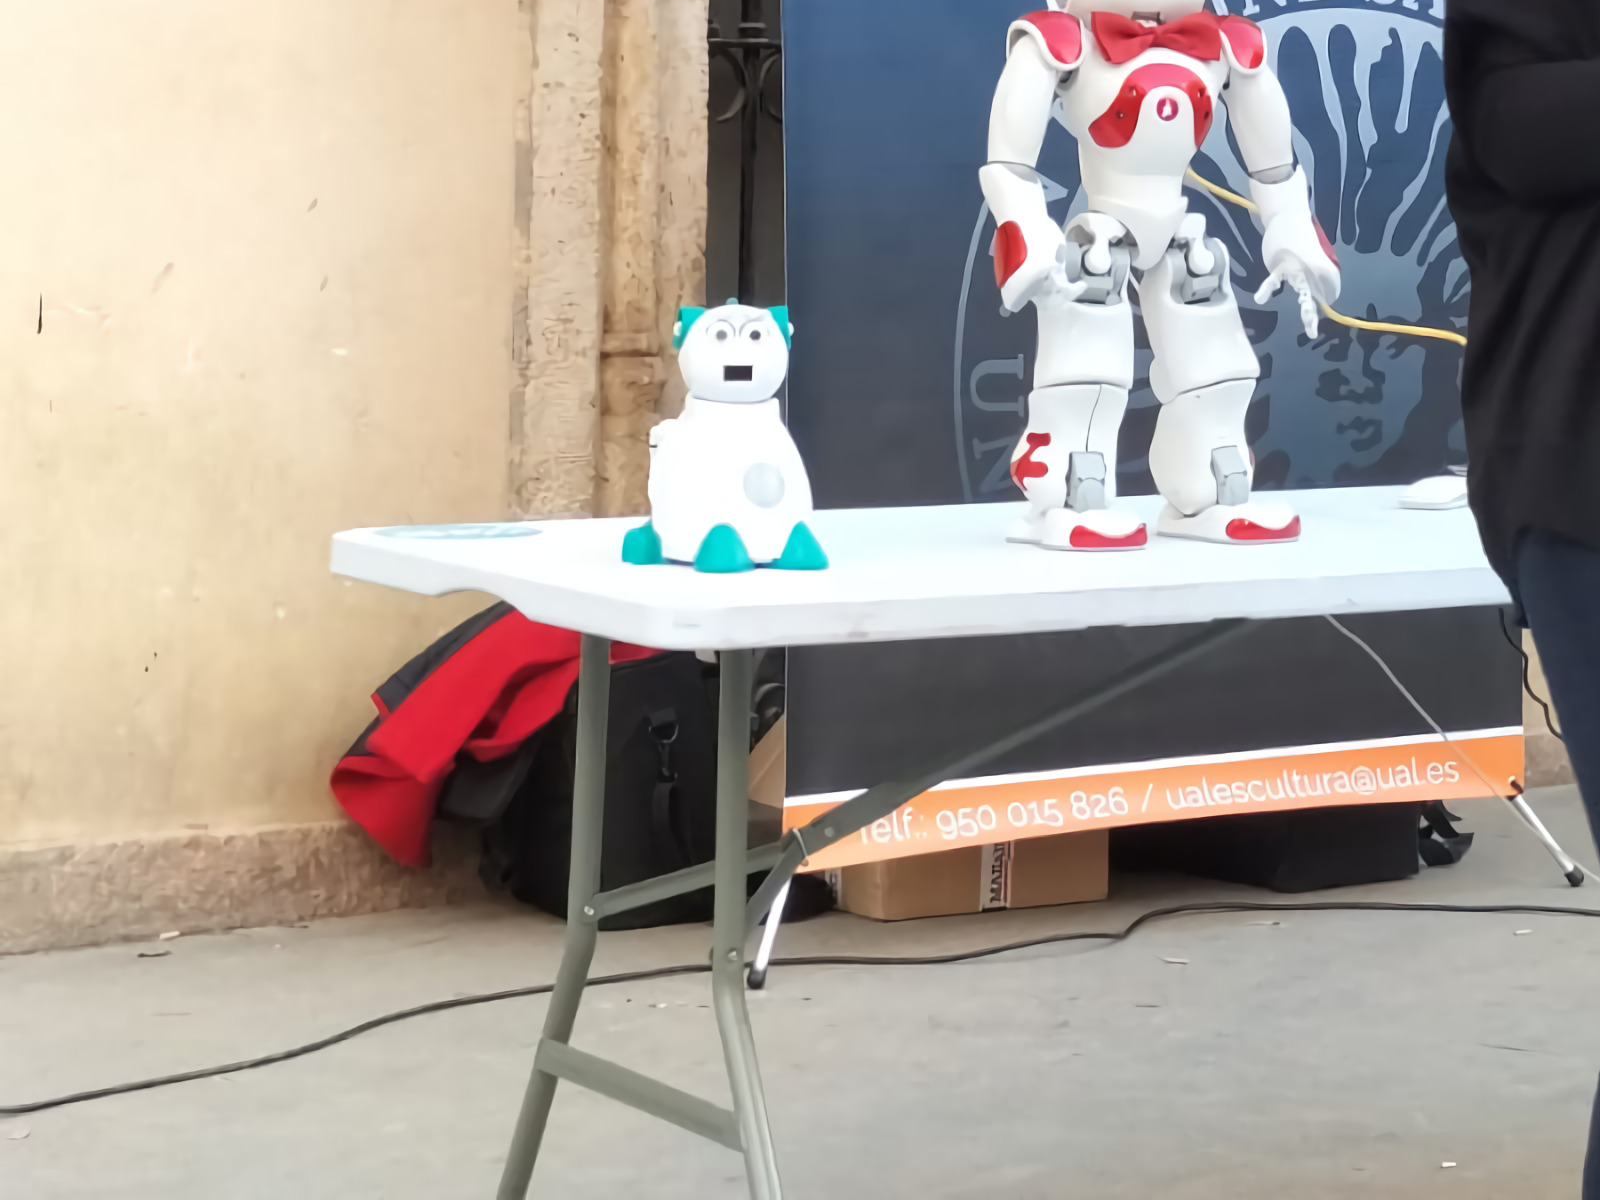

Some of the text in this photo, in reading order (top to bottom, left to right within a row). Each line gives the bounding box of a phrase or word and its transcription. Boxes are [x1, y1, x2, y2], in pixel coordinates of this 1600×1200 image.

[935, 804, 996, 841] 950
[1007, 798, 1064, 828] 015
[1069, 786, 1129, 820] 826
[1141, 783, 1154, 813] /
[1165, 756, 1460, 810] ualescultura@ual.es
